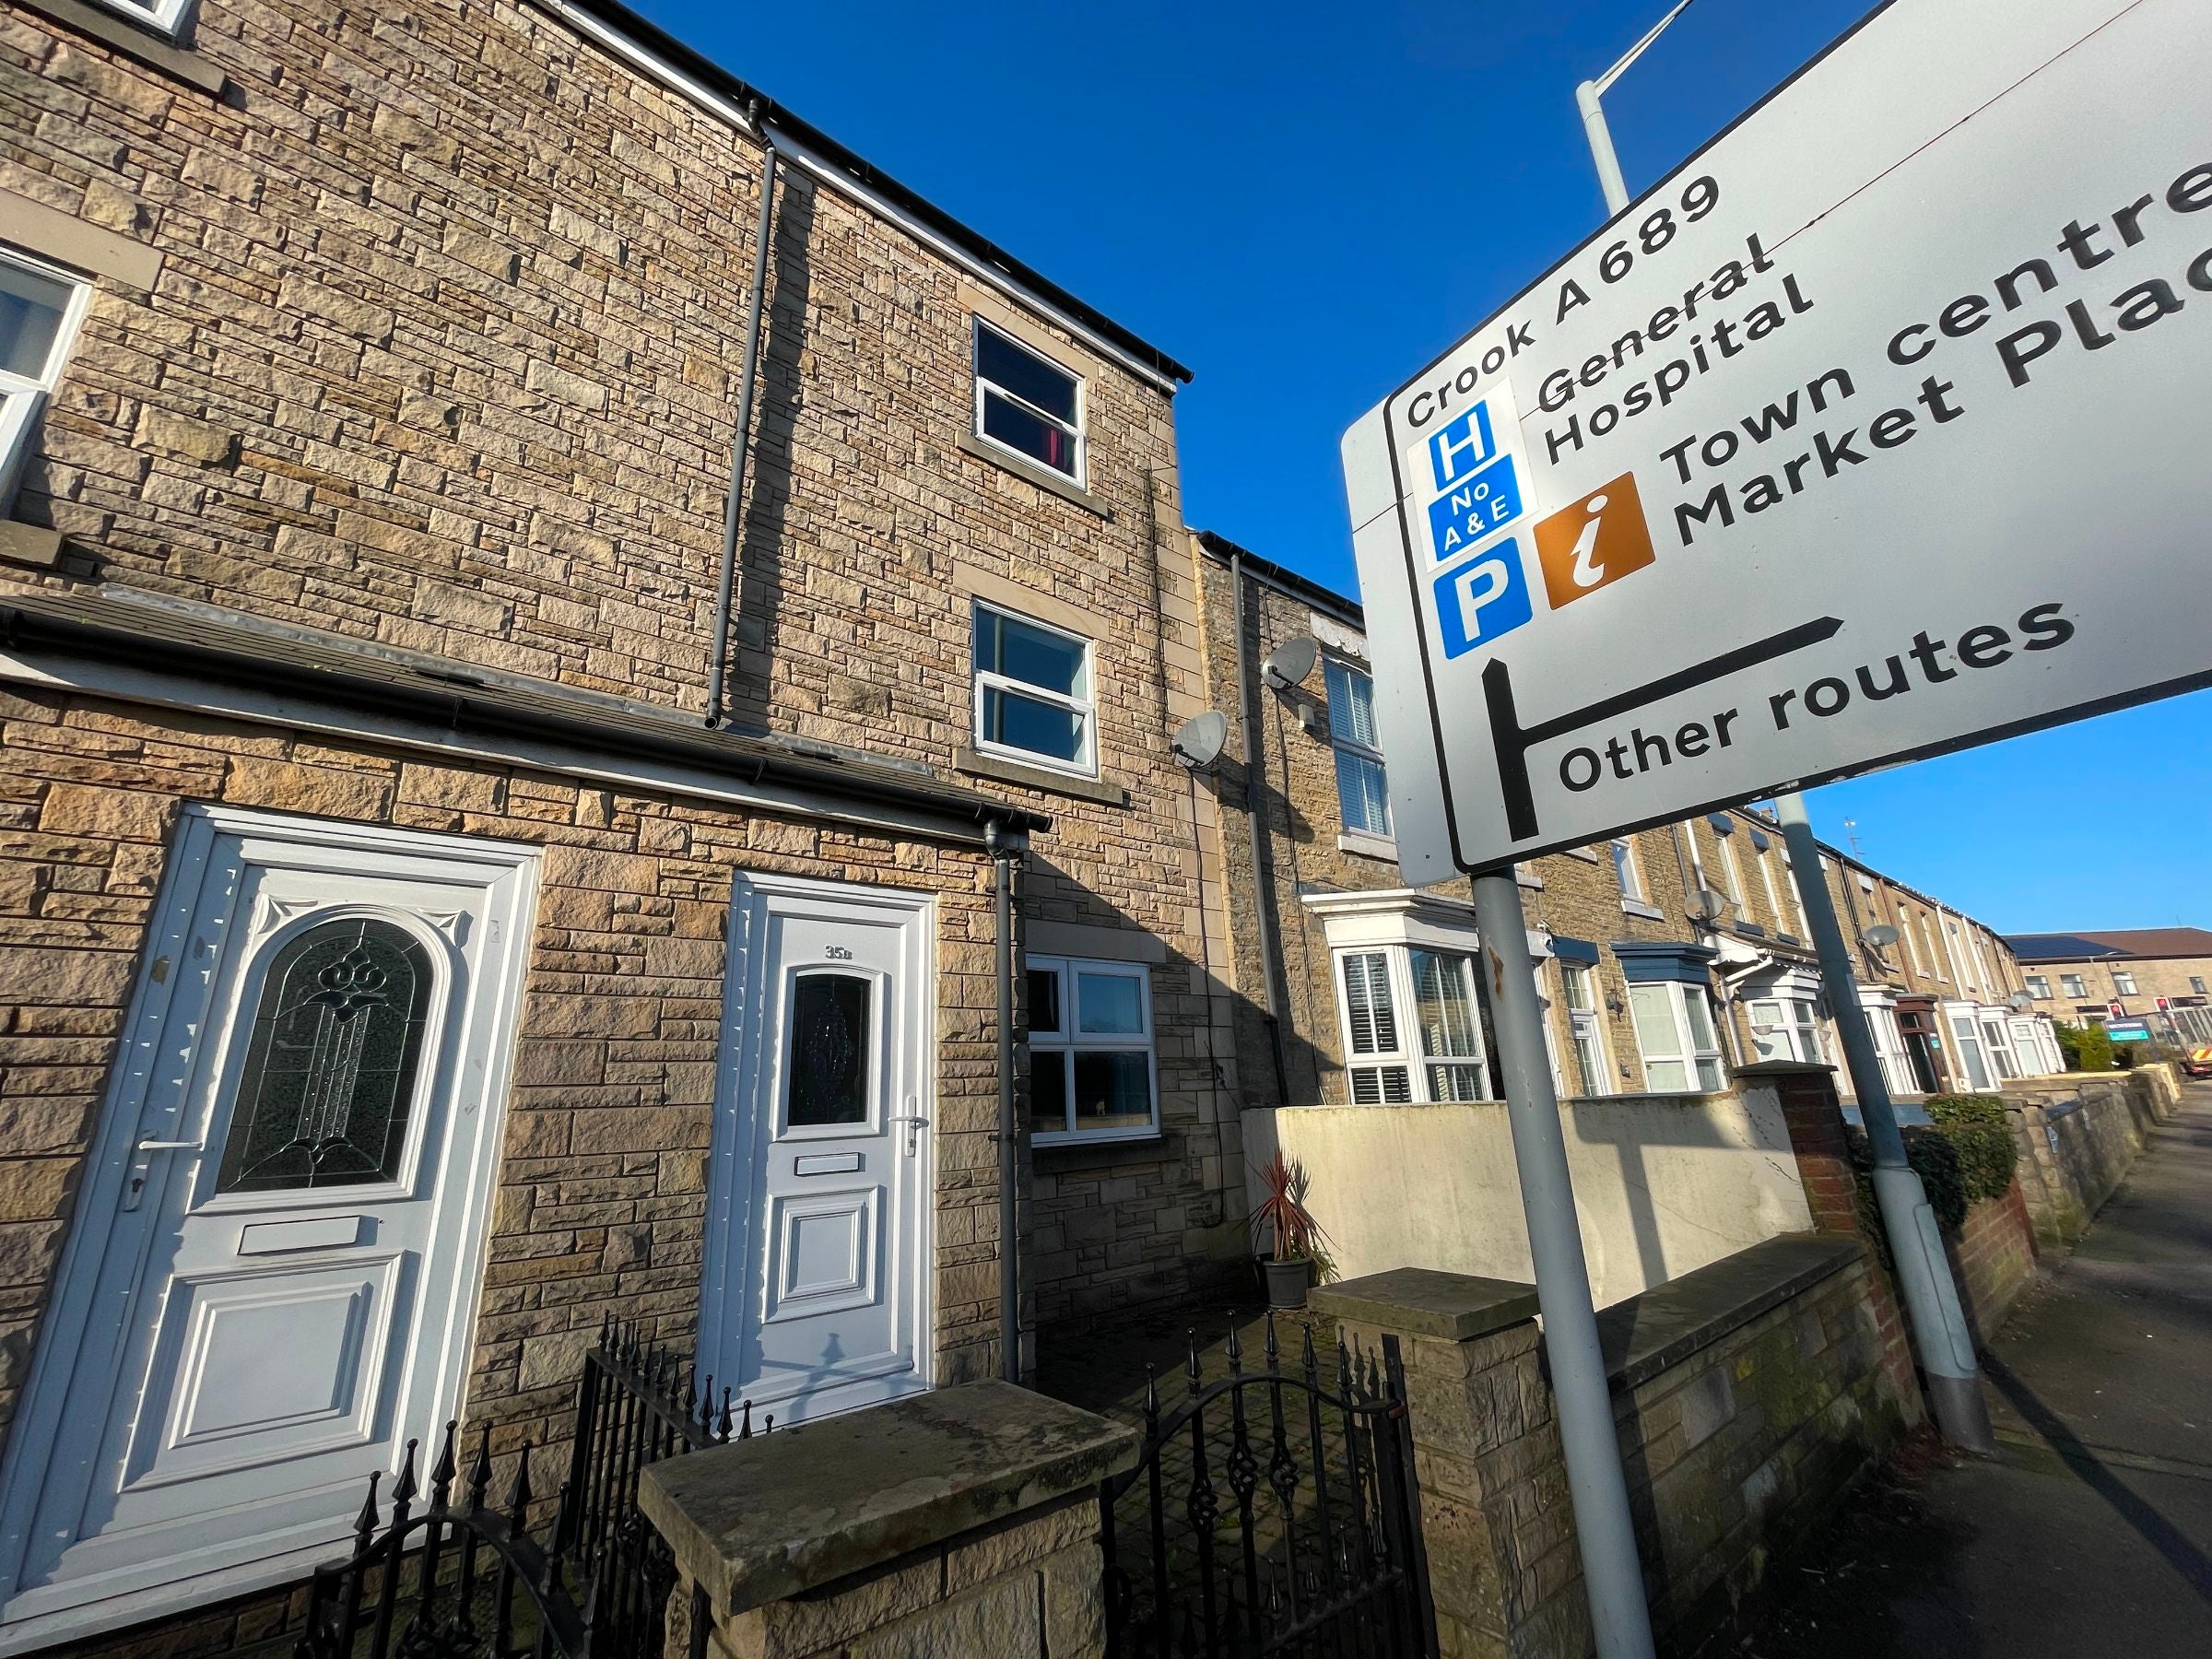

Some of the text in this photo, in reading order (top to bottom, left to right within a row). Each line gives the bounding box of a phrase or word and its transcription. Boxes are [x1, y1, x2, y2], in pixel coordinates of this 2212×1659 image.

[1408, 320, 1535, 428] Crook
[1539, 232, 1776, 413] General
[1546, 273, 1814, 466] Hospital
[1660, 161, 2212, 485] Town centre
[1439, 411, 1486, 481] H
[1452, 482, 1489, 516] No
[1674, 375, 1966, 547] Market
[1454, 559, 1509, 642] P
[1559, 602, 2076, 793] Other routes
